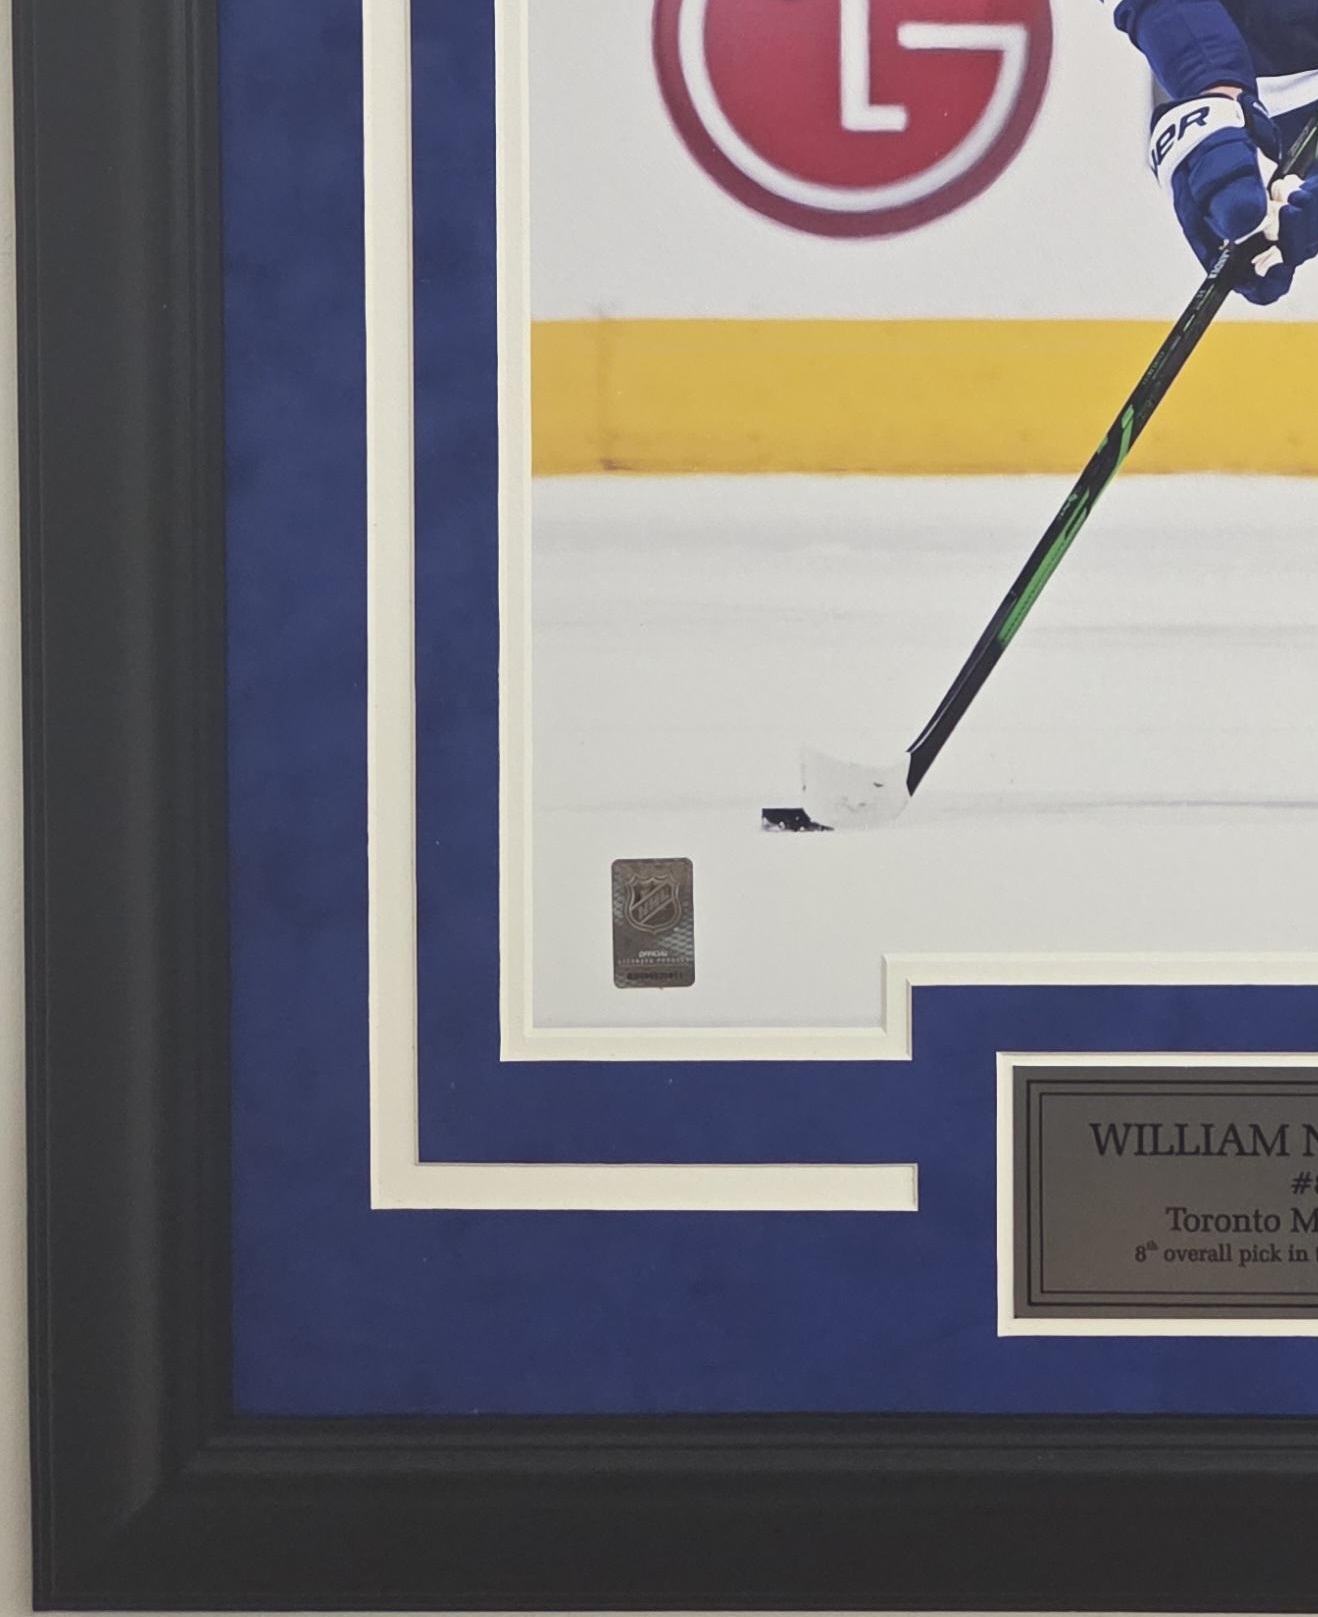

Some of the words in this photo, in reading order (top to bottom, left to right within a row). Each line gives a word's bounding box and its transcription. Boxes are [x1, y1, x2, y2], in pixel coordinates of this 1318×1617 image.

[1090, 1122, 1290, 1157] WILLIAM
[1165, 1206, 1281, 1233] Toronto
[1134, 1240, 1158, 1263] 8th
[1163, 1243, 1233, 1263] overall
[1238, 1243, 1283, 1268] pick
[1288, 1243, 1309, 1263] in
